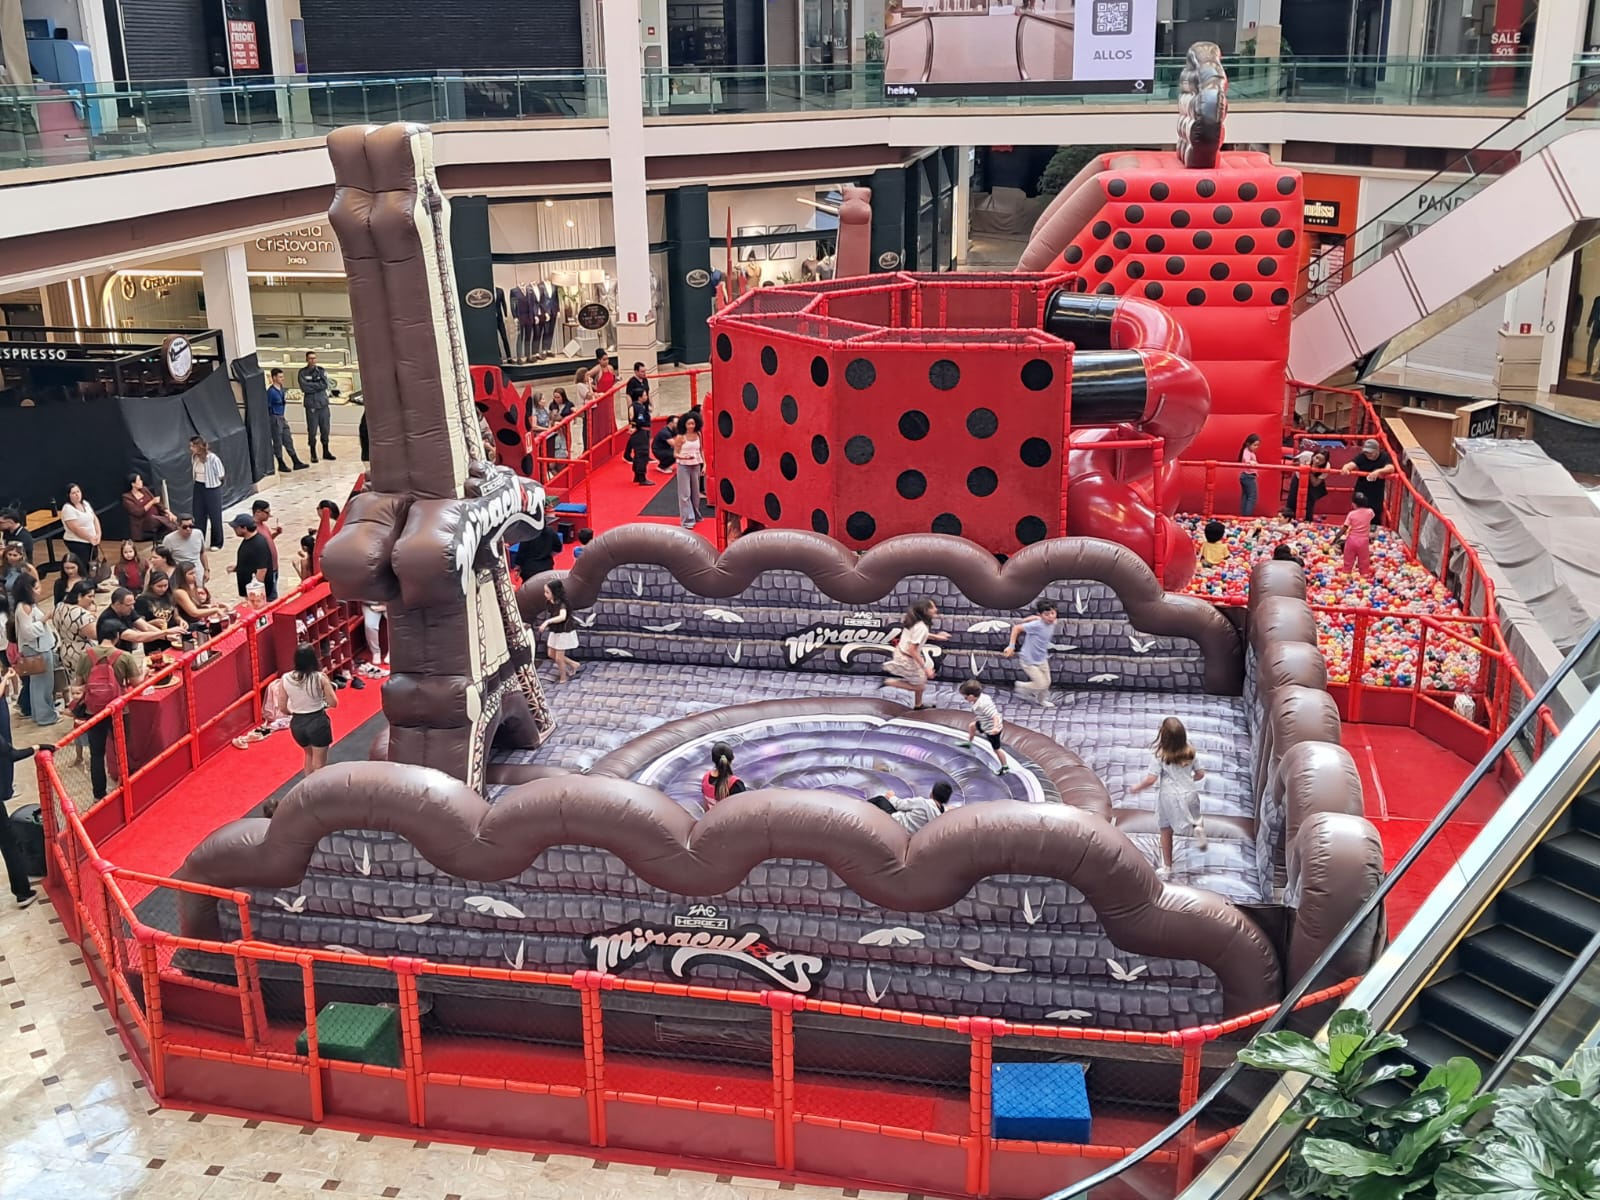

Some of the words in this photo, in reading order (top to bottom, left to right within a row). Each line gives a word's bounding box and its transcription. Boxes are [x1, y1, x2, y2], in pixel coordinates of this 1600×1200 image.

[1491, 32, 1521, 44] SALE
[1093, 50, 1133, 60] ALLOS
[1304, 202, 1335, 218] melissa
[256, 237, 336, 252] Cristovam
[0, 348, 66, 361] SPRESSO
[1471, 417, 1496, 437] CAIXA
[589, 926, 823, 993] Miraculous
